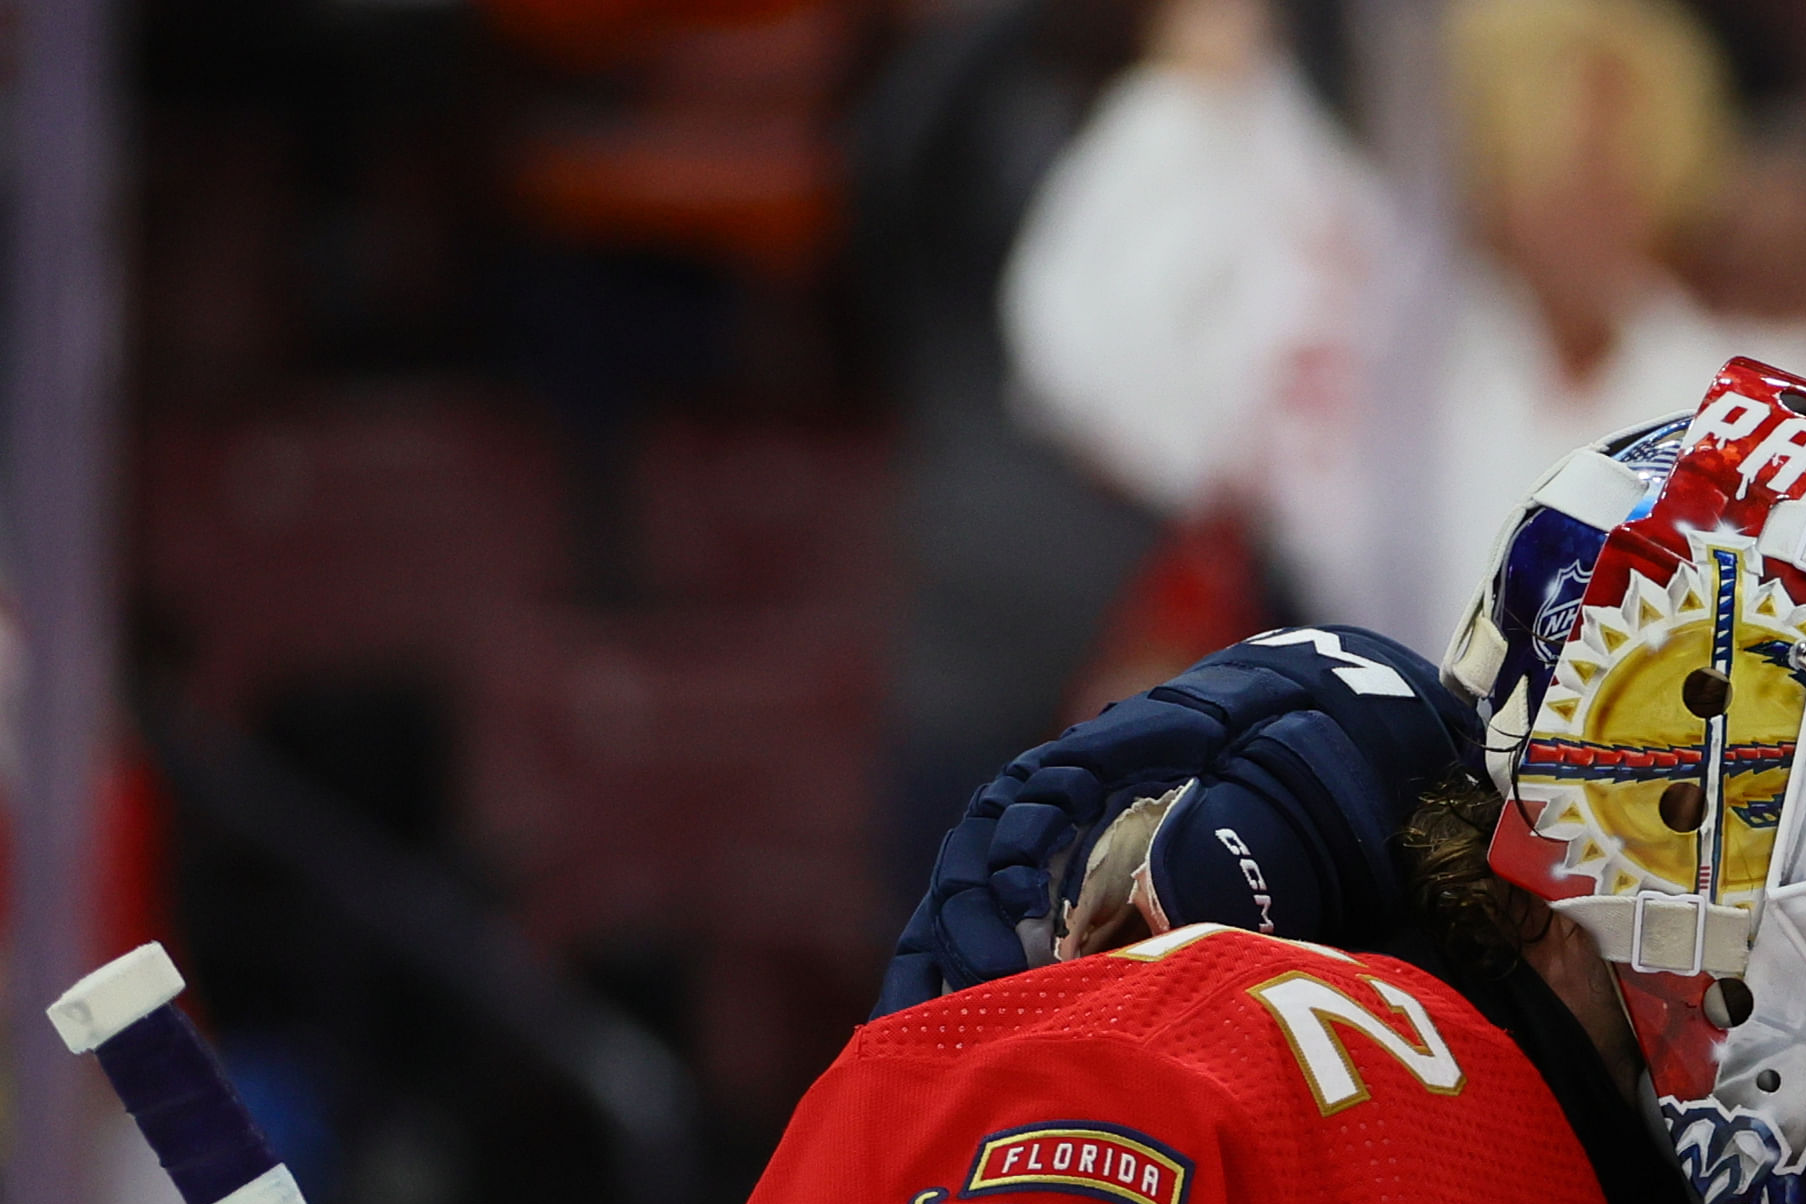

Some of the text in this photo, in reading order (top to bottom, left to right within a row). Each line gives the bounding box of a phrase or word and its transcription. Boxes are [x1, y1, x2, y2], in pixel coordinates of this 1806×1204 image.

[1543, 607, 1578, 639] NH
[1215, 828, 1275, 934] CCM
[1001, 1143, 1159, 1196] FLORIDA
